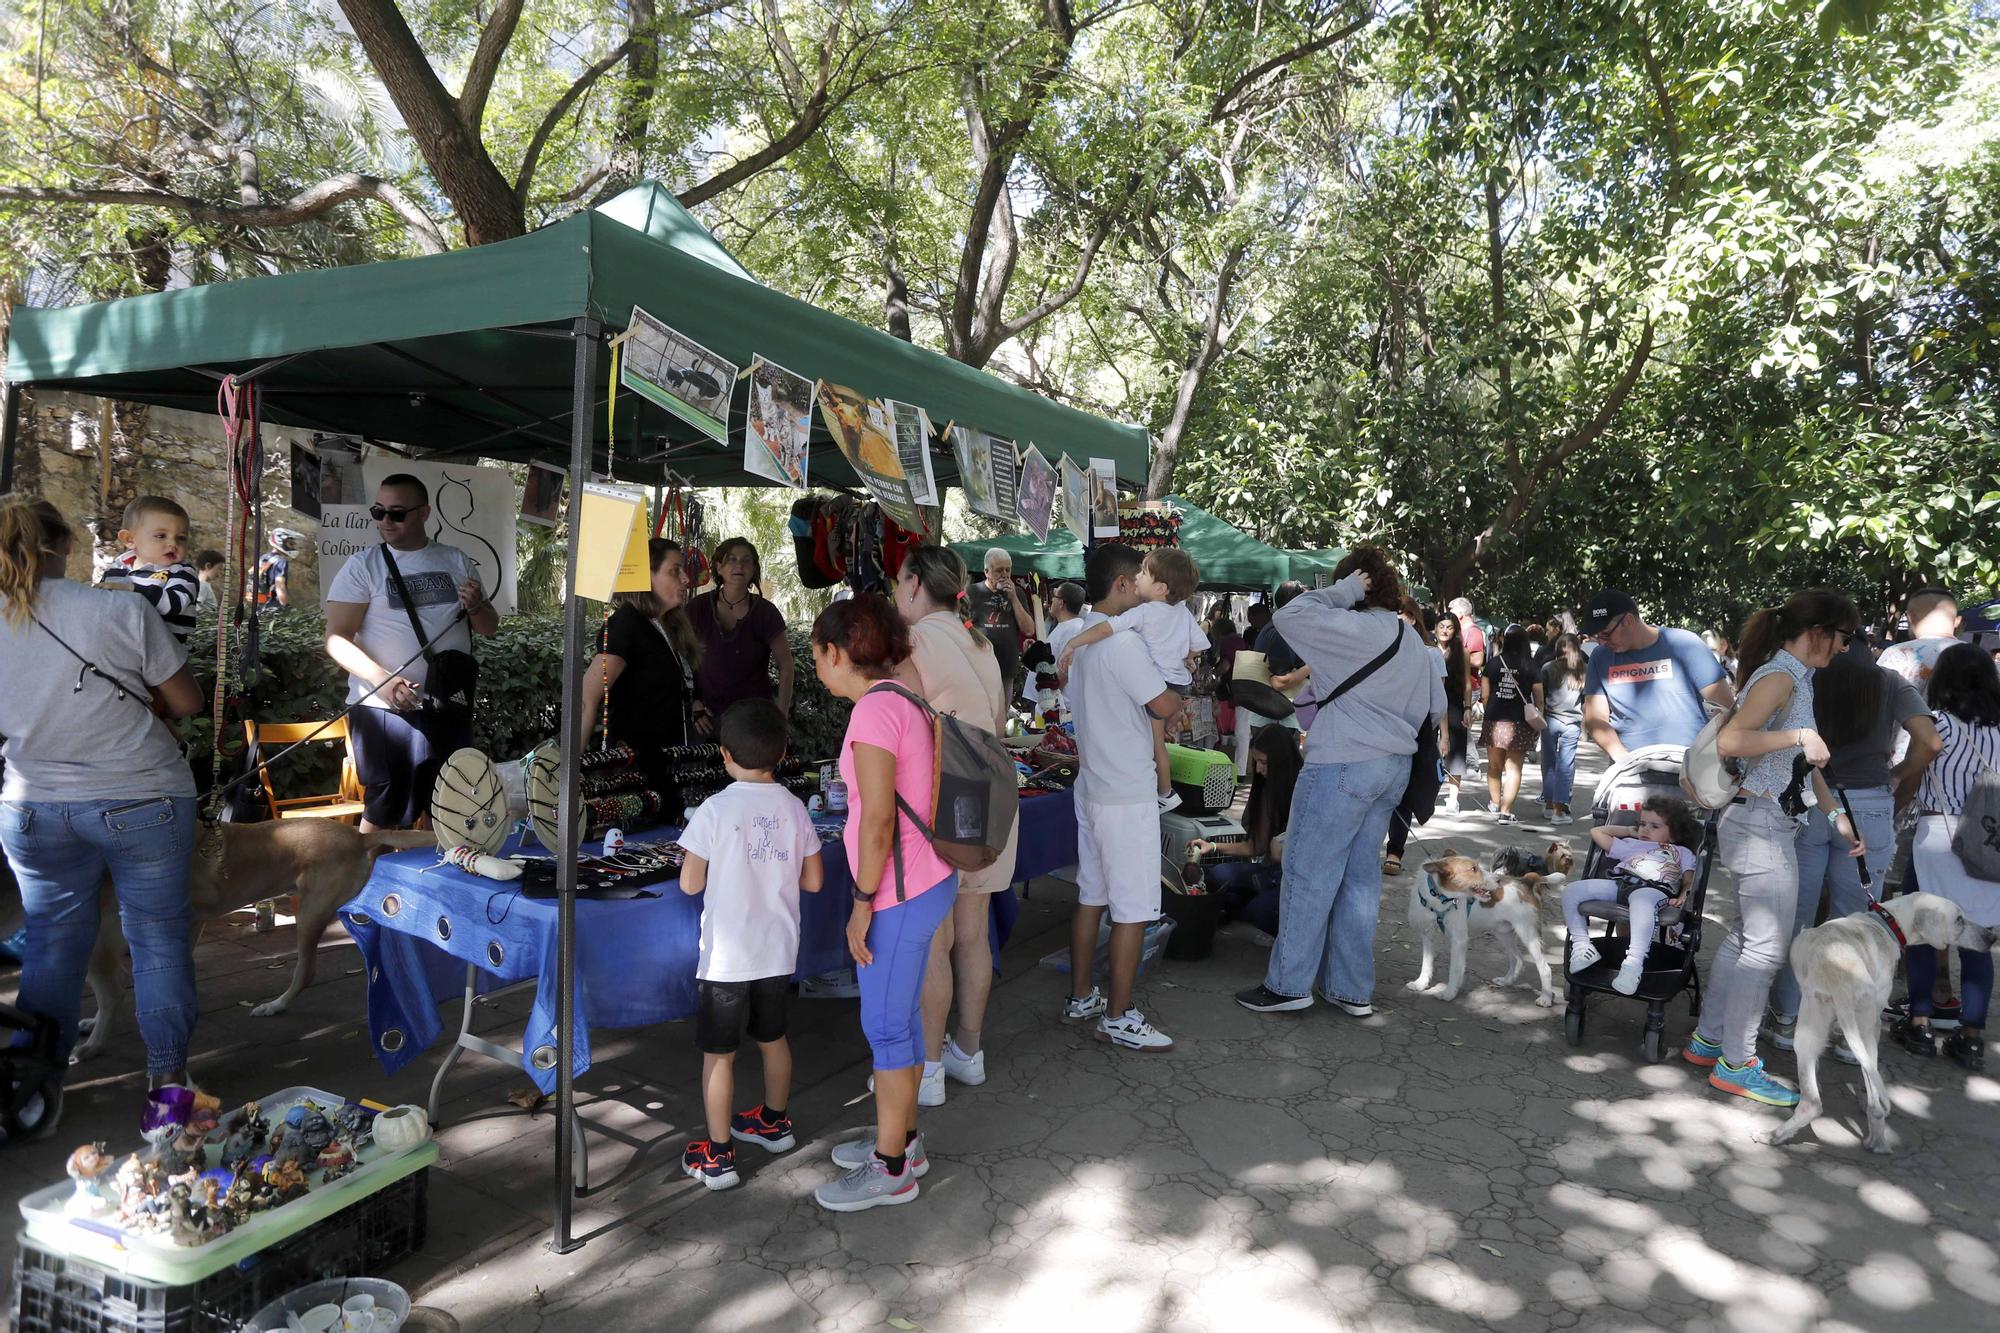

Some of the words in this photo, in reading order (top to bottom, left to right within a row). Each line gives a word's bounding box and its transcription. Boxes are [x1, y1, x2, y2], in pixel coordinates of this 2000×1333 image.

[321, 512, 339, 528] La
[345, 512, 372, 529] llar
[1611, 665, 1668, 678] ORIGNALS
